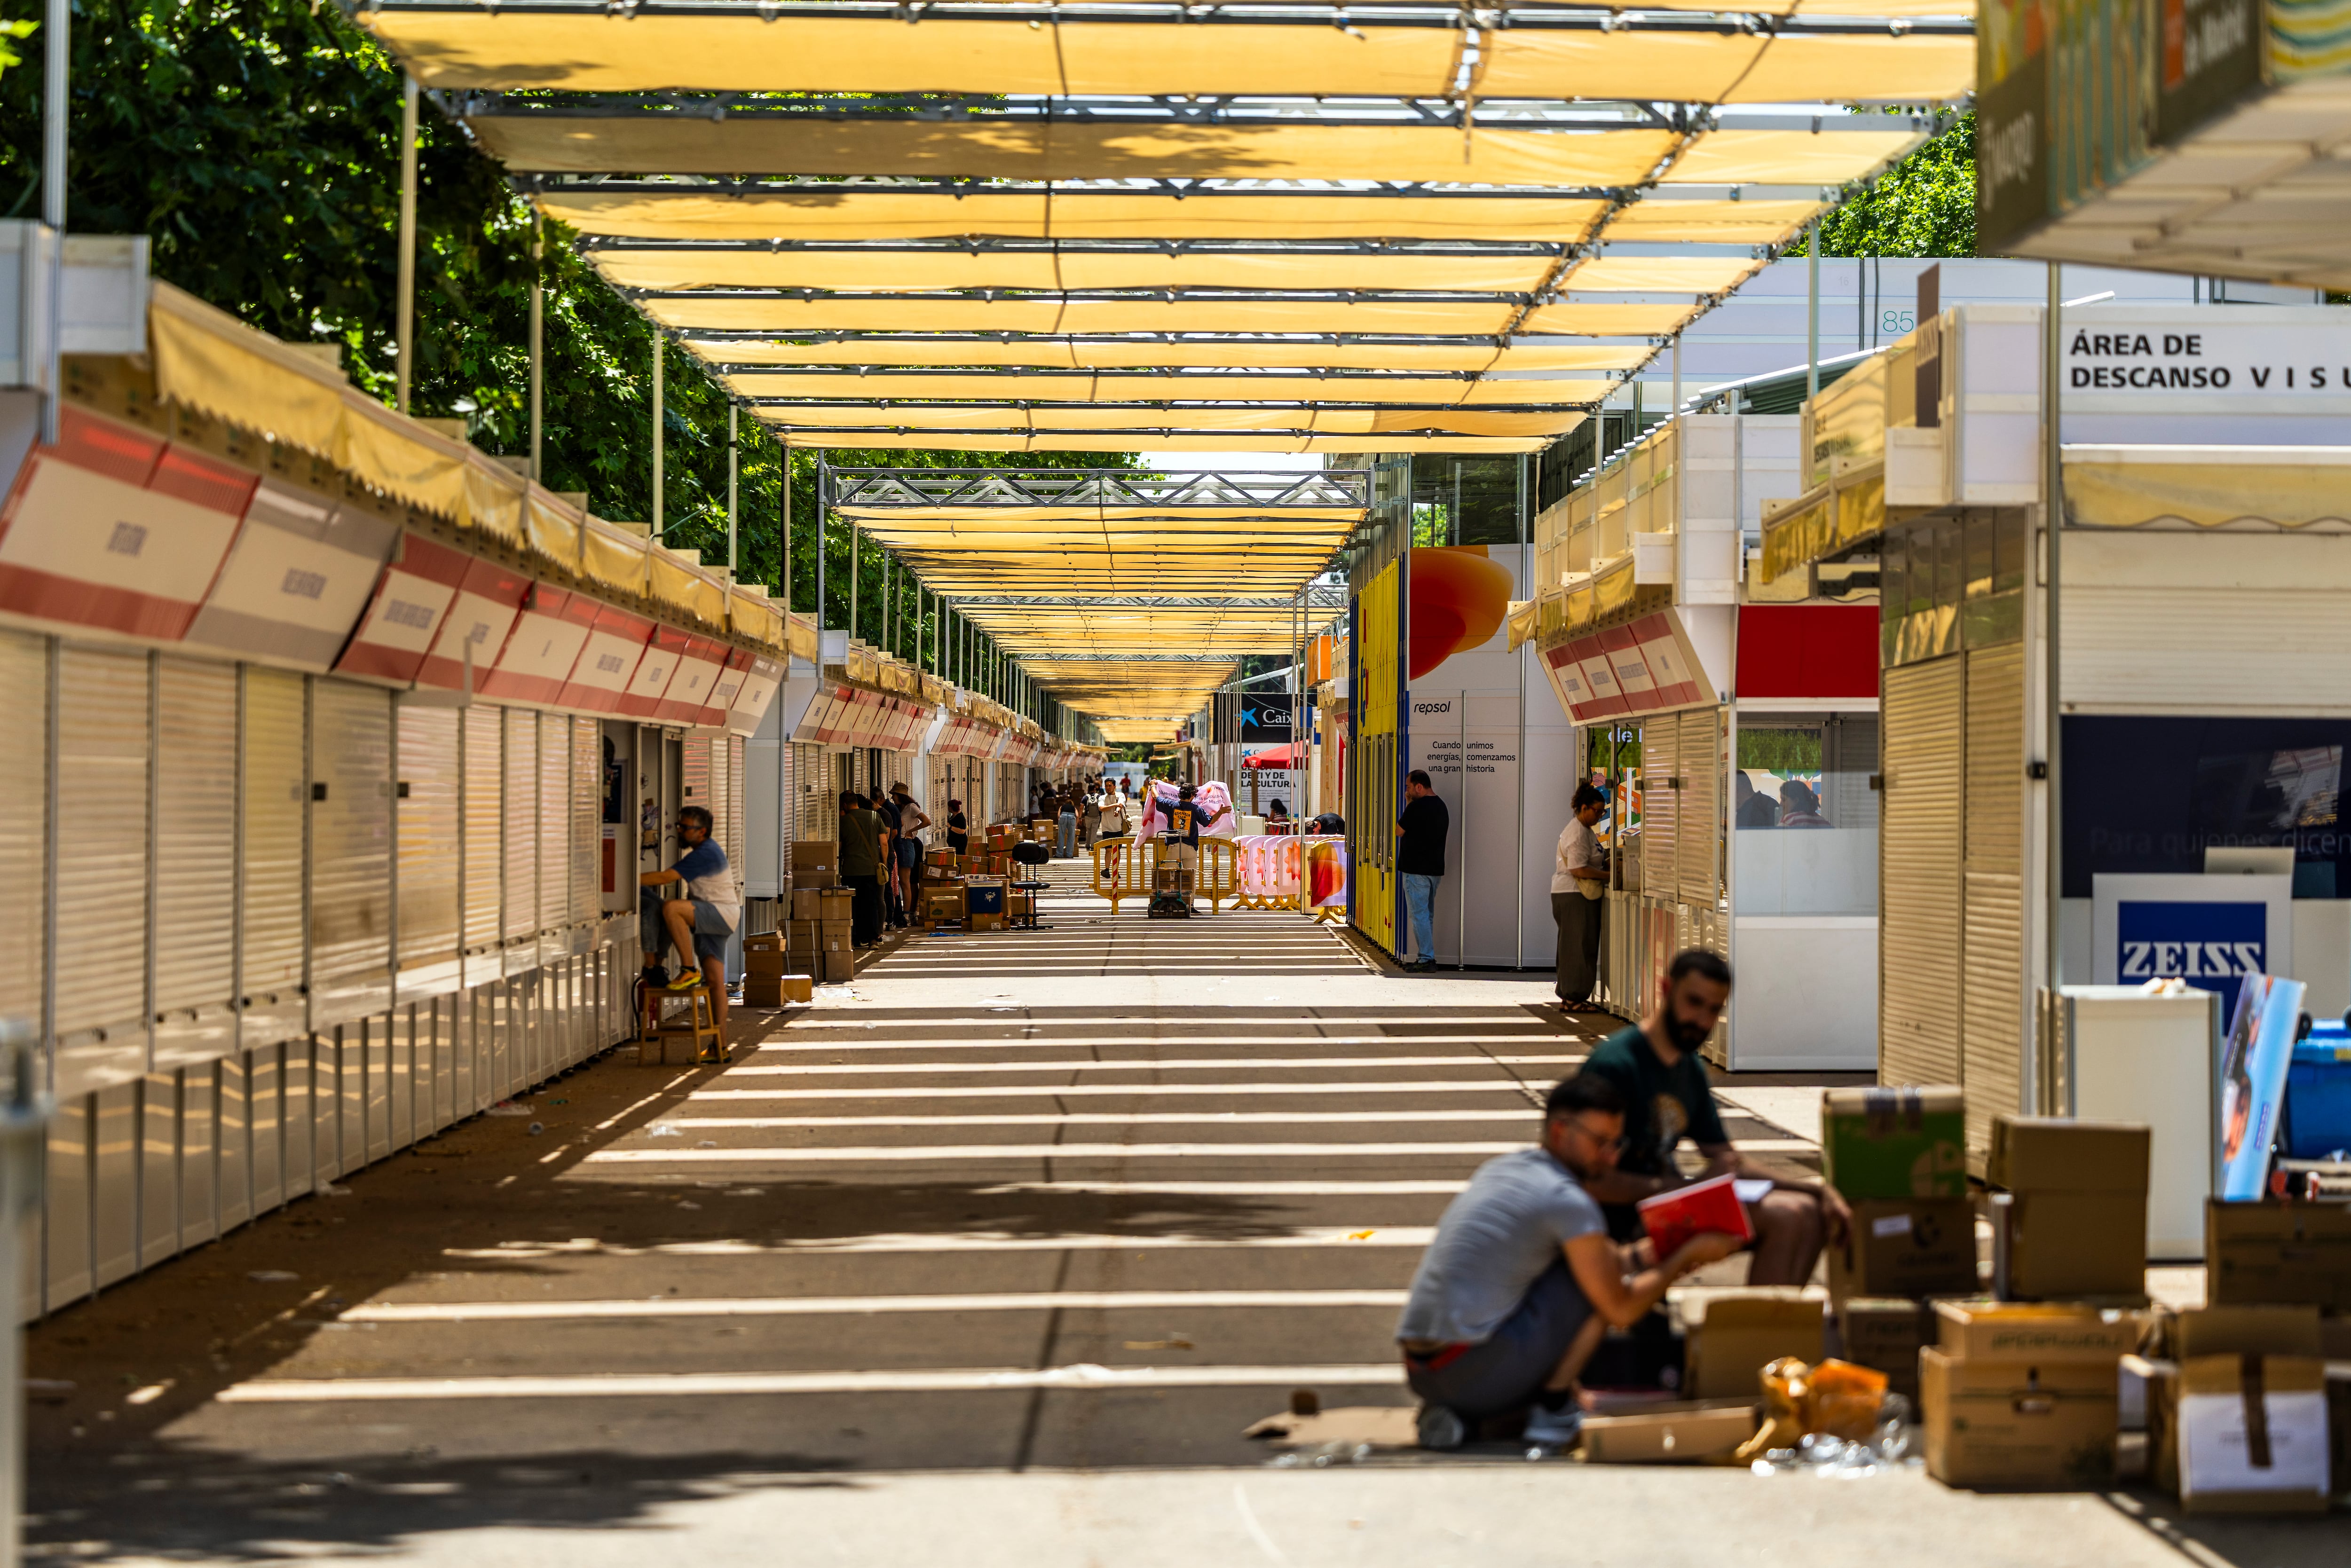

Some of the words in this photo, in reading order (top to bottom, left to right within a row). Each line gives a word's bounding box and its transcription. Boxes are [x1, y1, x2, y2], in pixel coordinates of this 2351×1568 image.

[1883, 310, 1914, 332] 85
[2070, 329, 2153, 355] ÁREA
[2163, 334, 2201, 355] DE
[2070, 366, 2231, 388] DESCANSO
[1414, 701, 1451, 715] repsol
[1427, 753, 1461, 762] energías,
[2122, 941, 2262, 977] ZEISS
